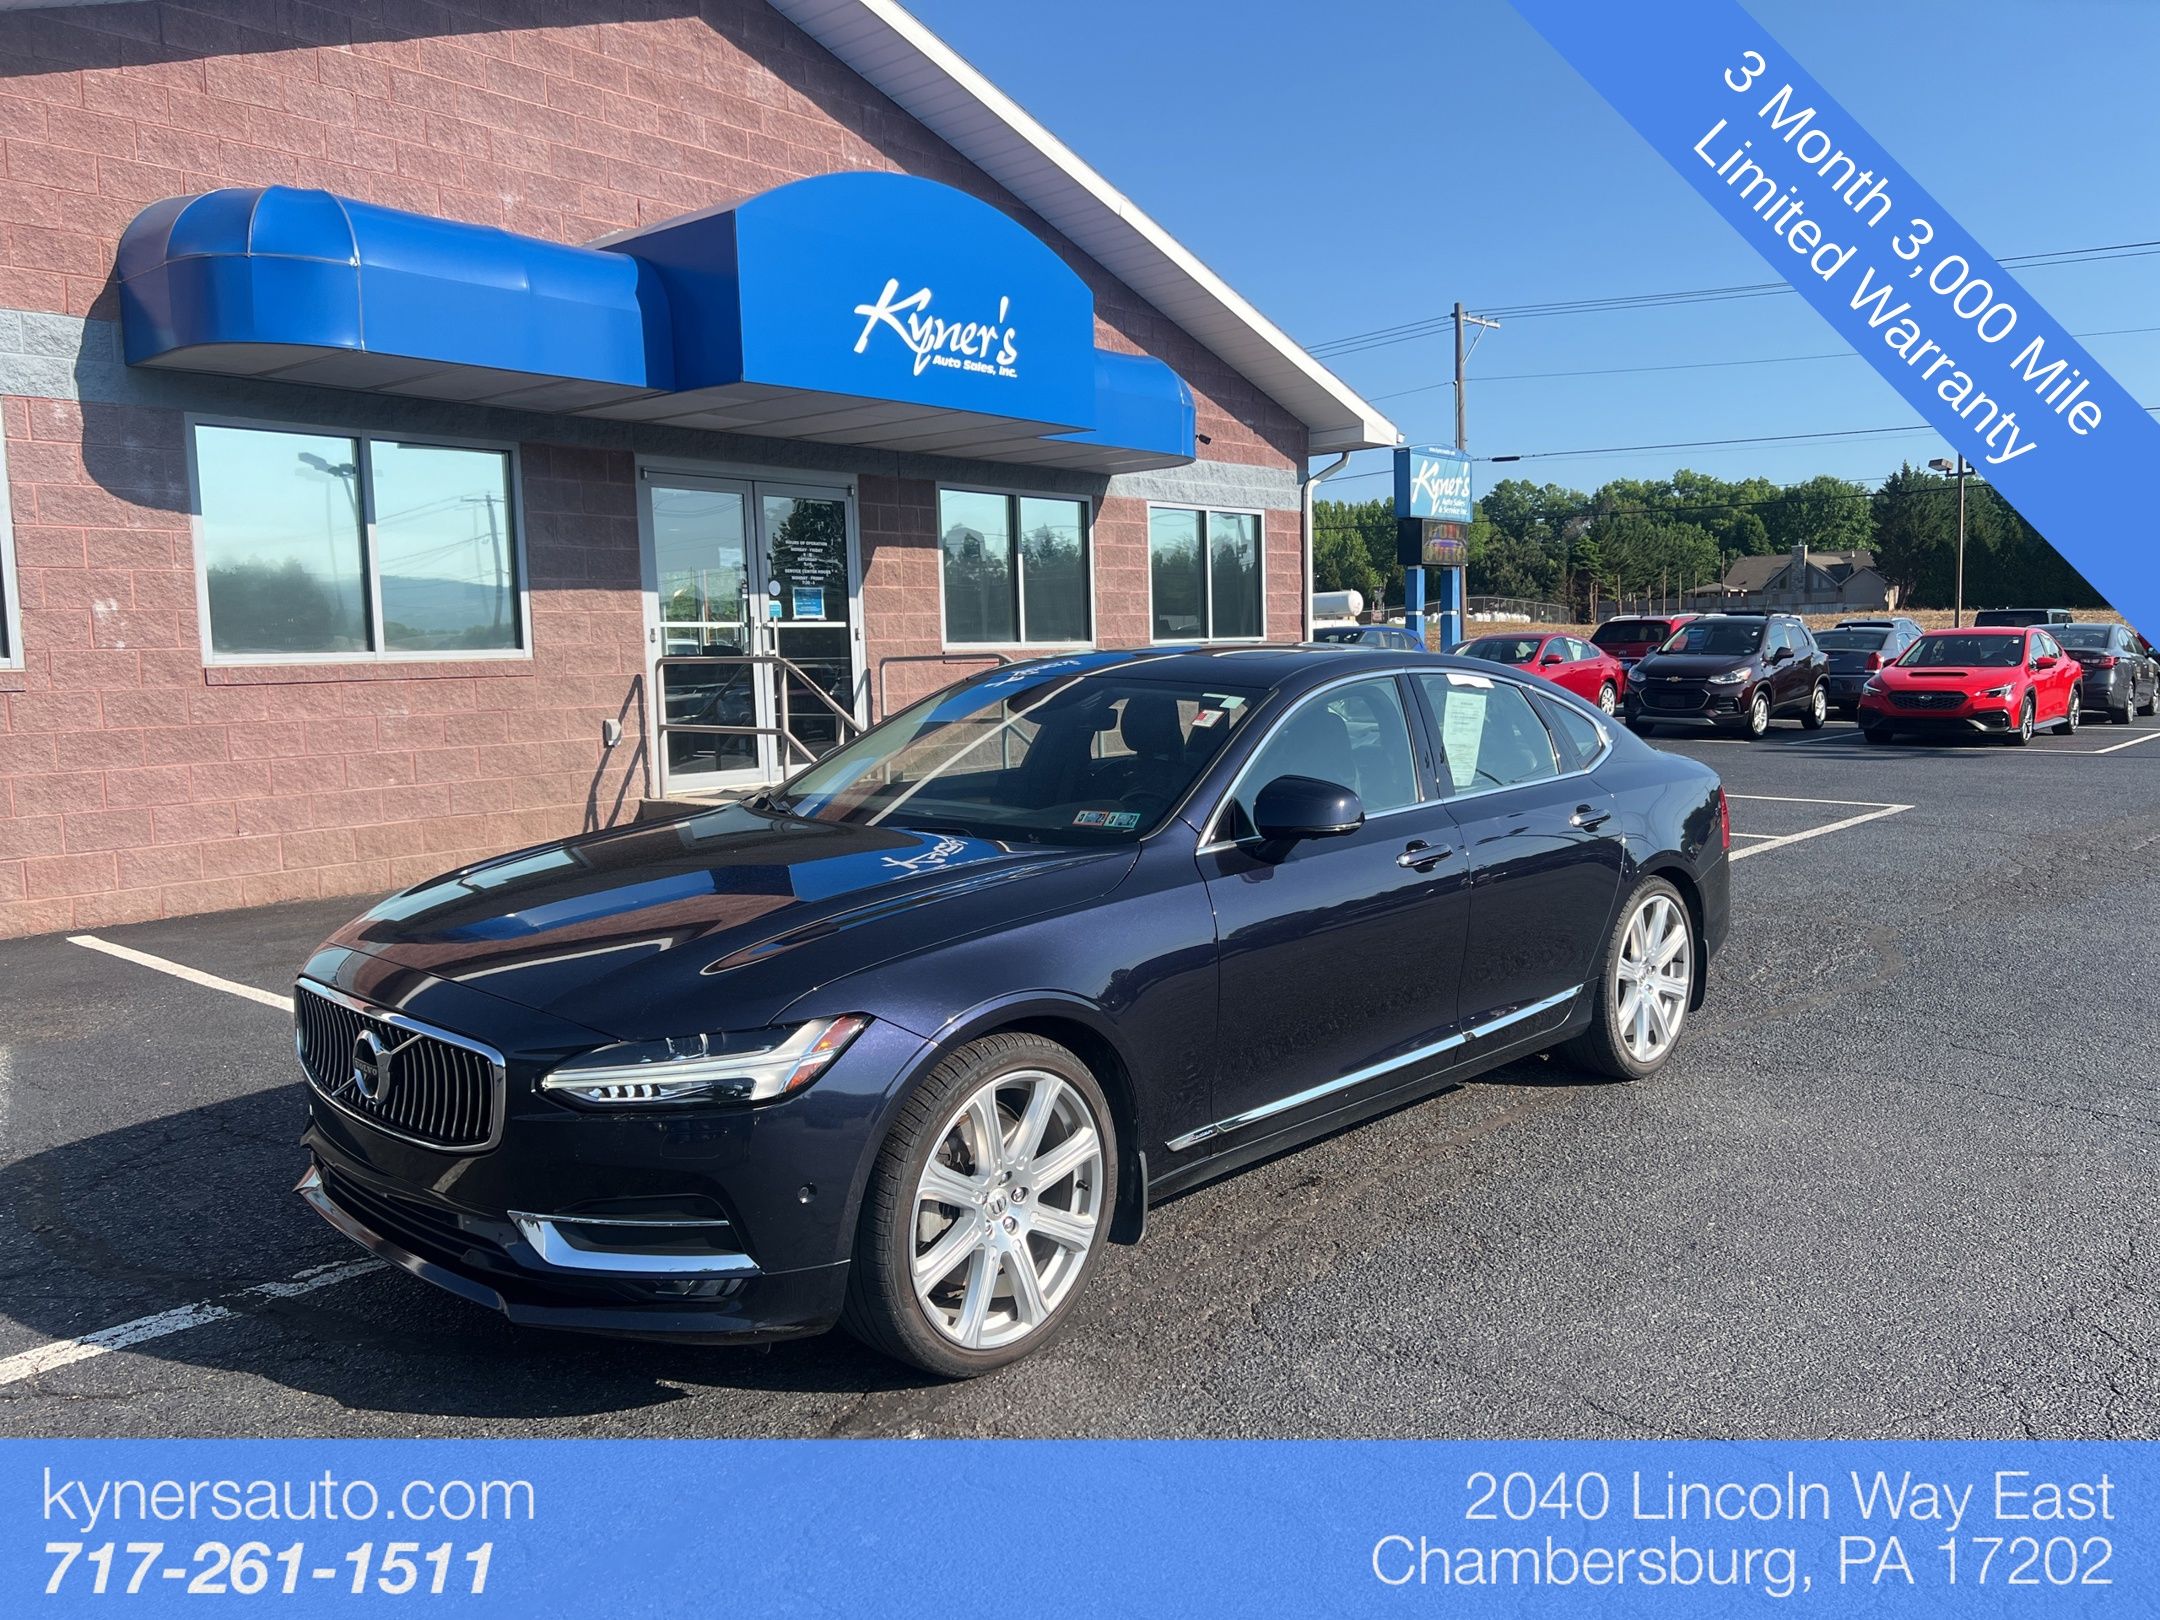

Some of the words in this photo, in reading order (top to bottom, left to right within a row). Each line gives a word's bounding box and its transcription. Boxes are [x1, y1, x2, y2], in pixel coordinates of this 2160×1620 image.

[854, 278, 1018, 377] Kyner's
[932, 354, 962, 369] Auto
[962, 359, 997, 376] Sales,
[998, 365, 1018, 378] Inc.
[1412, 459, 1470, 516] Kyner's
